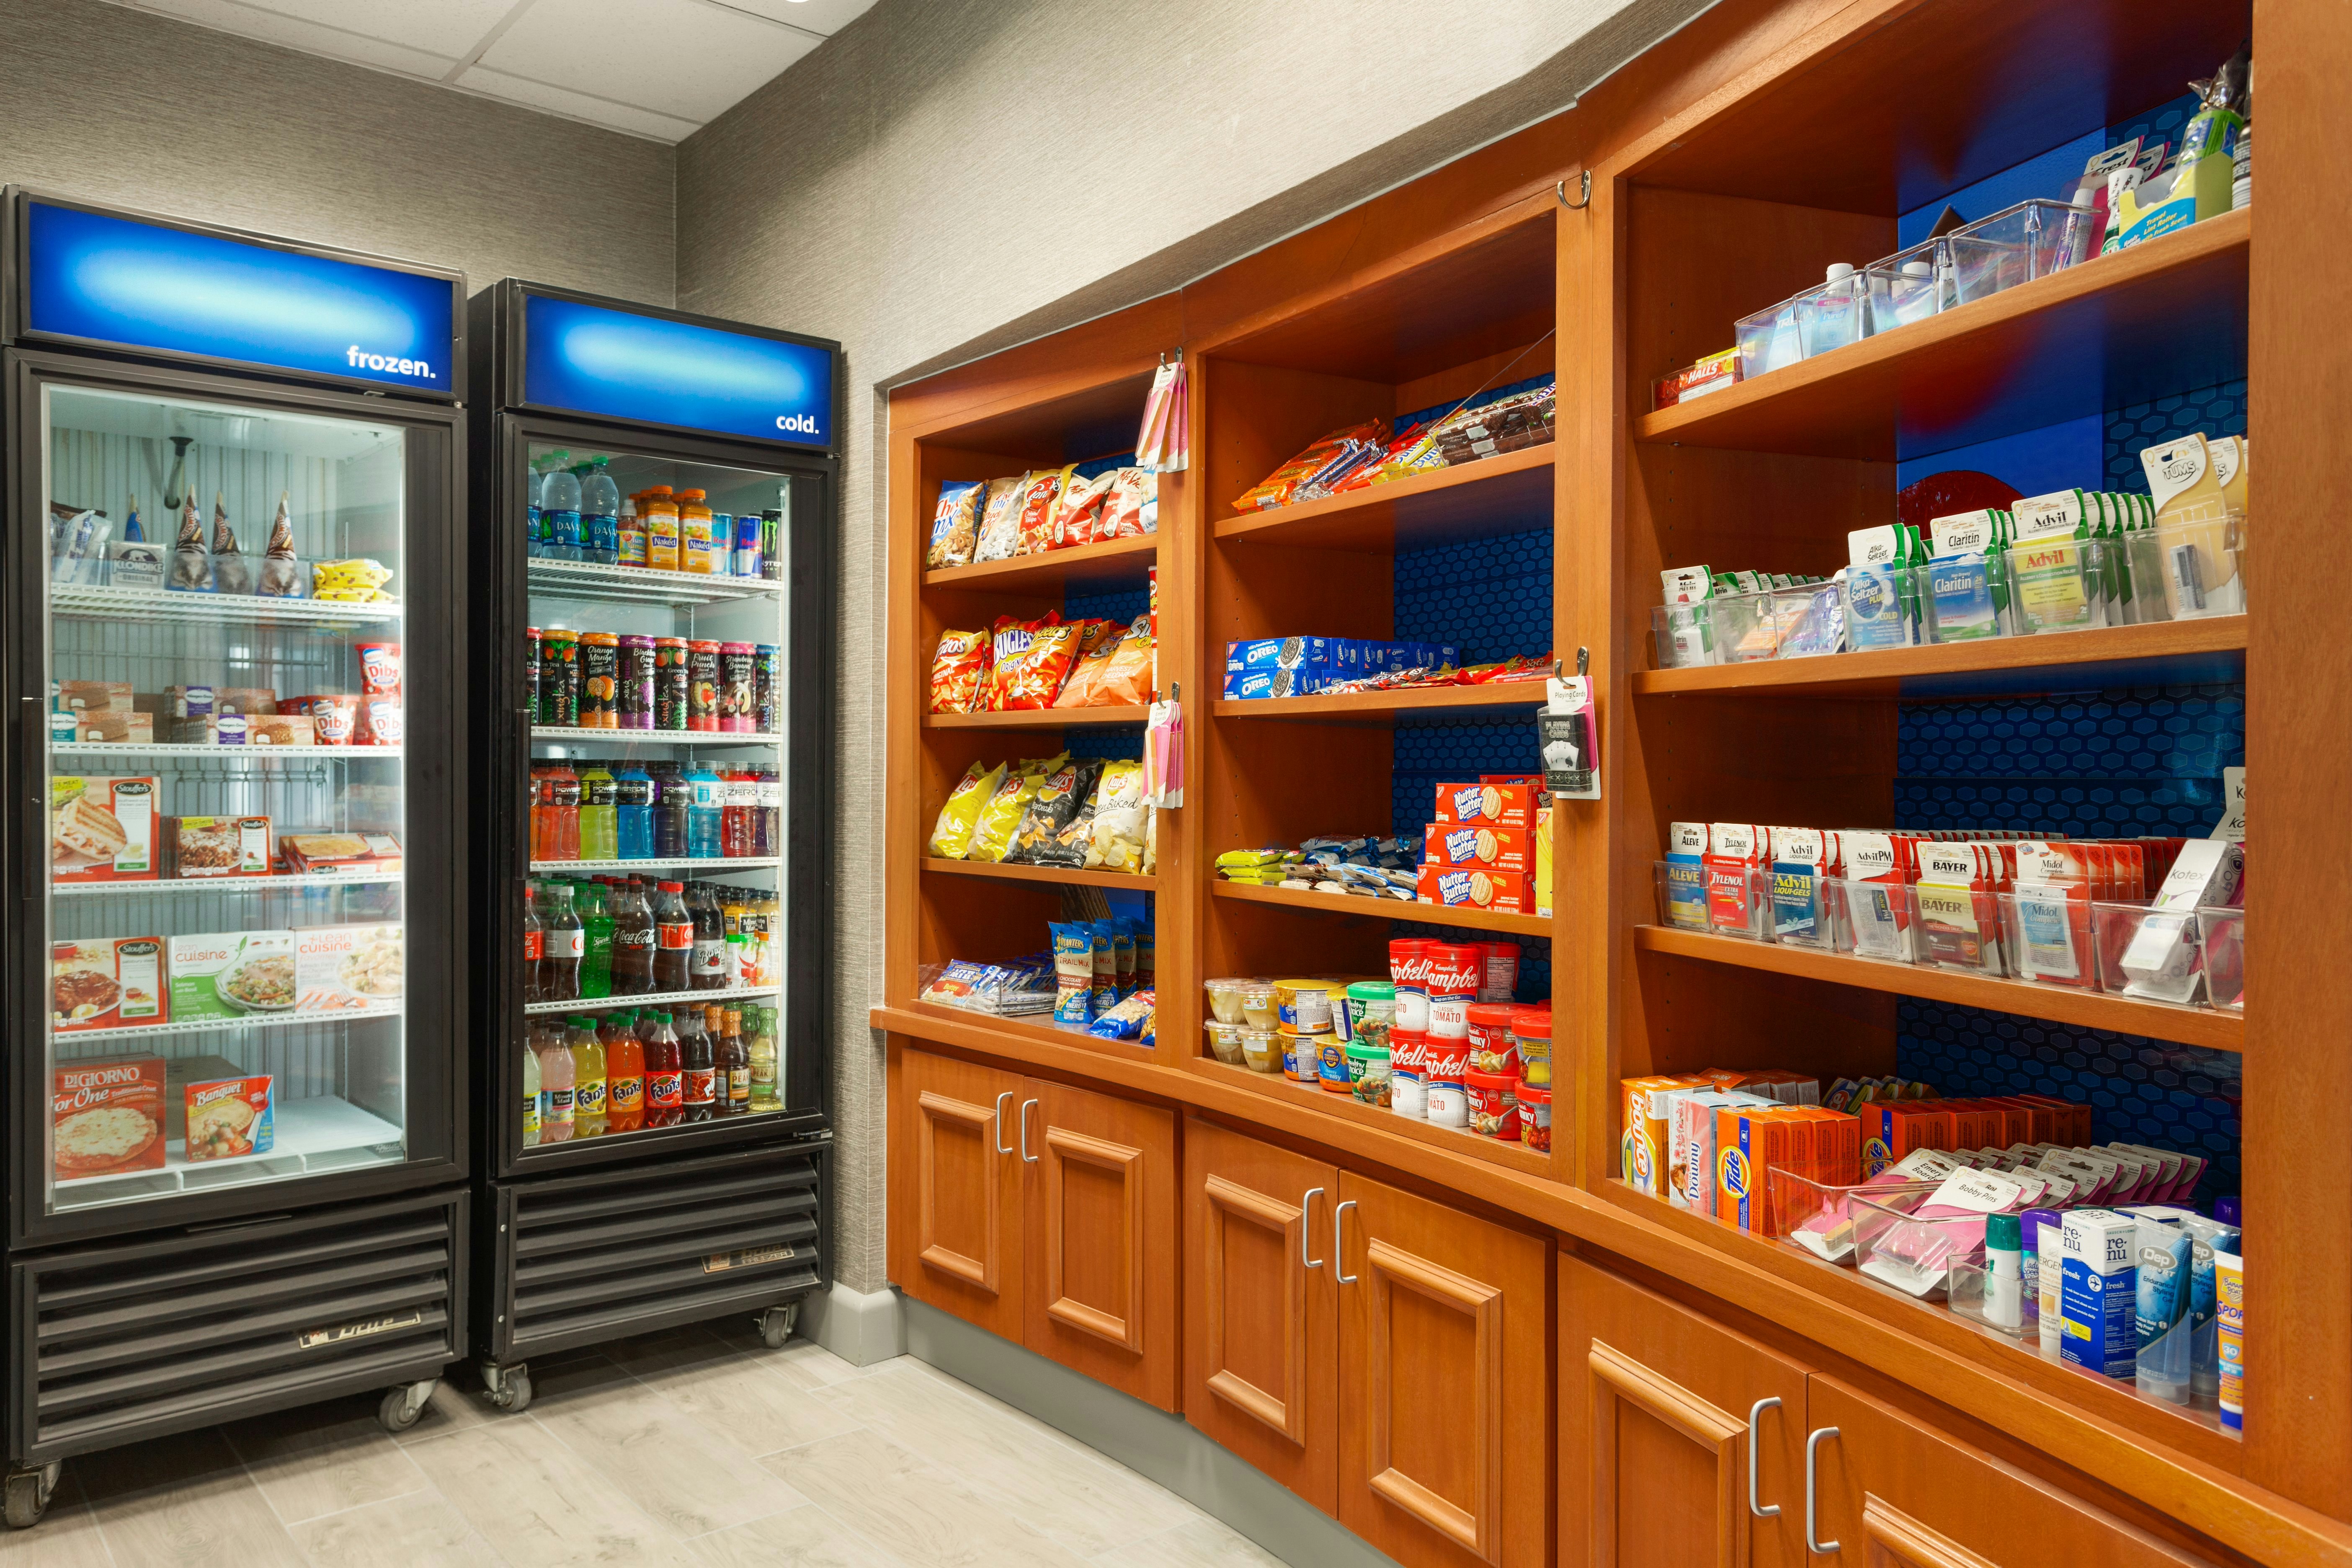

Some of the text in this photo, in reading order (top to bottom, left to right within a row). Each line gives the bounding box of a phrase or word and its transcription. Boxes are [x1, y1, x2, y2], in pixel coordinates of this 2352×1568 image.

[2143, 213, 2177, 235] Lint Roller
[2146, 211, 2166, 226] Travel
[1823, 311, 1844, 320] Purell
[347, 346, 436, 378] frozen.
[1688, 363, 1718, 384] HALLS
[776, 414, 819, 434] cold.
[2162, 461, 2196, 479] TUMS
[2033, 511, 2067, 528] Advil
[654, 537, 676, 546] Naked
[1949, 534, 1980, 547] Claritin
[1867, 550, 1888, 562] Seltzer
[1868, 544, 1884, 554] Alka-
[2026, 549, 2064, 568] Advil
[112, 560, 164, 573] KLONDIKE
[1852, 579, 1873, 592] Alka-
[1935, 577, 1971, 593] Claritin
[1851, 586, 1880, 603] Seltzer
[1869, 593, 1885, 605] PLUS
[1879, 612, 1898, 620] COLD
[588, 654, 612, 663] Mango
[725, 656, 753, 665] Strawberry
[1247, 645, 1278, 663] OREO
[369, 663, 398, 678] Dibs
[1242, 678, 1270, 696] OREO
[317, 715, 348, 730] Dibs
[119, 784, 149, 793] Stouffer's
[1109, 775, 1128, 789] Lay's
[1454, 787, 1480, 807] Nutter
[1458, 797, 1482, 820] Butter
[1446, 829, 1474, 849] Nutter
[1681, 836, 1699, 846] ALEVE
[1725, 838, 1746, 848] TYLENOL
[1449, 839, 1477, 862] Butter
[1789, 845, 1813, 855] Advil
[1857, 851, 1892, 862] Advil PM
[1933, 861, 1968, 872] BAYER
[2042, 860, 2063, 869] Midol
[1439, 872, 1467, 892] Nutter
[1669, 868, 1699, 882] ALEVE
[1711, 872, 1743, 886] TYLENOL
[1774, 874, 1811, 889] Advil
[2170, 869, 2206, 881] kotex
[1443, 881, 1471, 904] Butter
[1774, 887, 1810, 897] LIQUI-GELS
[1921, 900, 1962, 913] BAYER
[2032, 905, 2058, 917] Midol
[2030, 915, 2061, 925] Complete
[619, 928, 654, 944] Coca-Cola
[124, 944, 155, 953] Stouffer's
[175, 950, 227, 962] cuisine
[1060, 957, 1077, 965] TRAIL
[1433, 1011, 1460, 1023] TOMATO
[196, 1083, 242, 1106] Banquet
[613, 1078, 641, 1099] Fanta
[651, 1081, 680, 1097] Fanta
[75, 1088, 109, 1108] One
[1632, 1093, 1646, 1175] bounce
[1689, 1142, 1702, 1201] Downy
[1726, 1149, 1744, 1194] Tide
[1920, 1162, 1944, 1178] Emery
[1958, 1183, 1998, 1203] Bobby Pins
[2063, 1238, 2081, 1253] nu
[2107, 1249, 2127, 1261] nu
[2143, 1248, 2170, 1266] Dep
[2063, 1267, 2081, 1280] fresh
[2106, 1281, 2125, 1289] fresh
[2143, 1276, 2175, 1290] Endurance
[2152, 1285, 2174, 1297] Styling
[2223, 1346, 2238, 1355] 30
